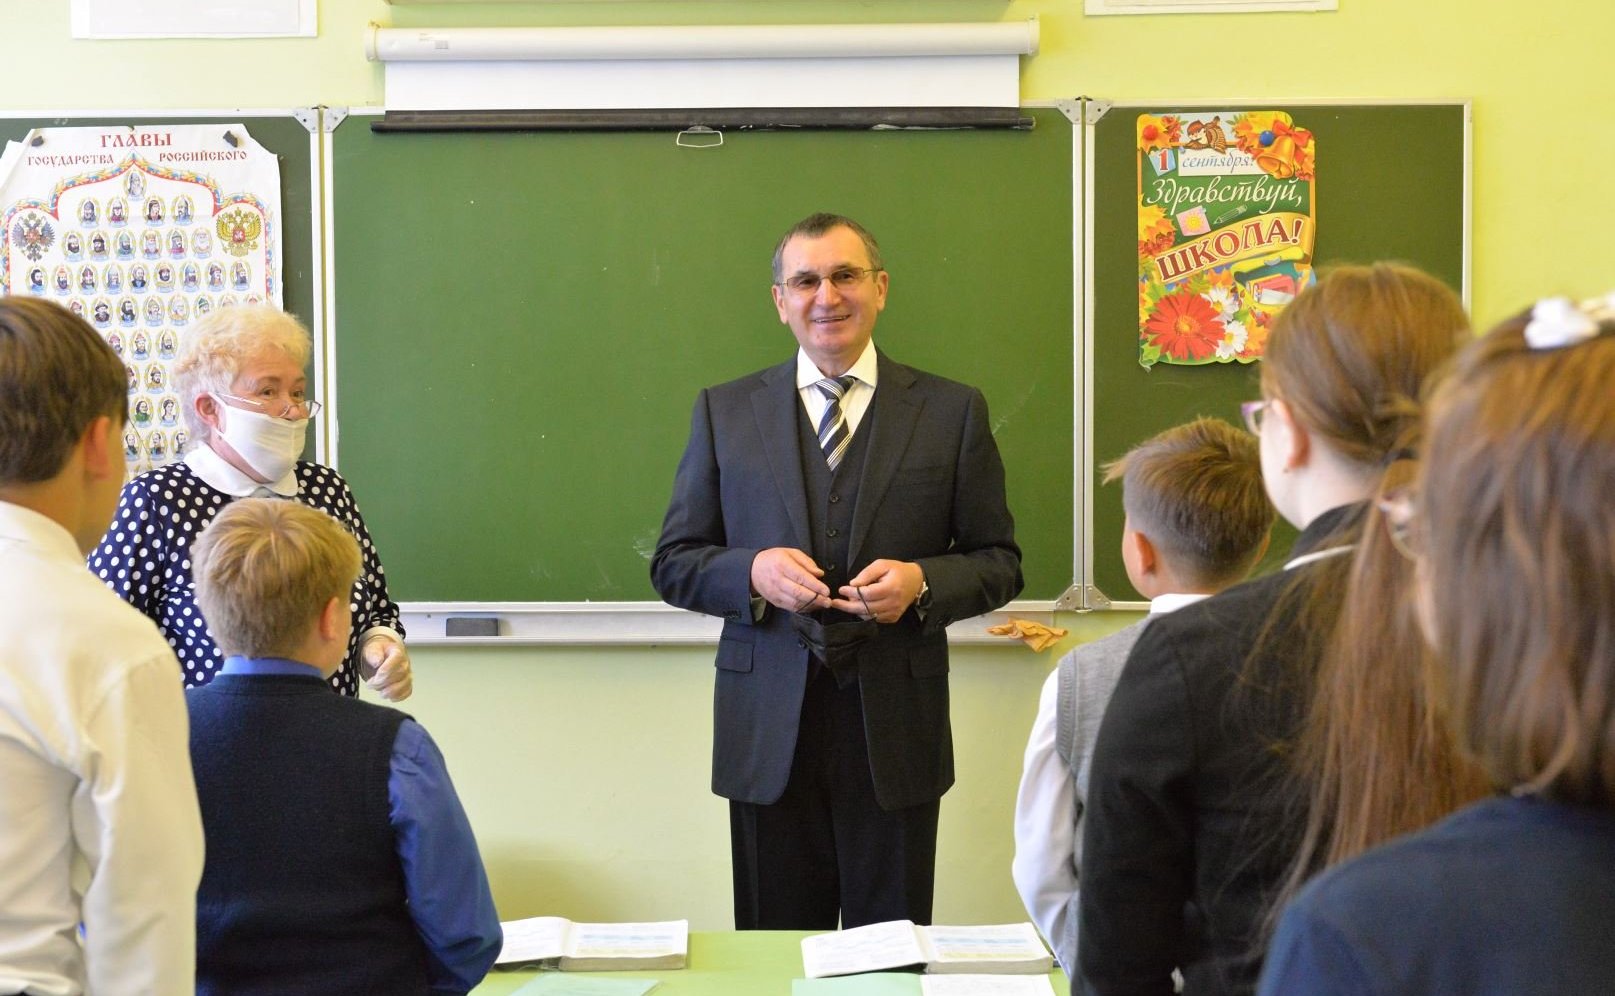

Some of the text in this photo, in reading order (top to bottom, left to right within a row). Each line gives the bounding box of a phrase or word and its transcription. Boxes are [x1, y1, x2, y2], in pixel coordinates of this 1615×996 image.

[100, 132, 172, 148] ГЛАВЫ
[27, 149, 248, 167] ГОСУДАРСТВА РОССИЙСКОГО
[1158, 148, 1169, 171] 1
[1147, 175, 1303, 215] Здравствуй,
[1157, 219, 1303, 281] ШКОЛА!
